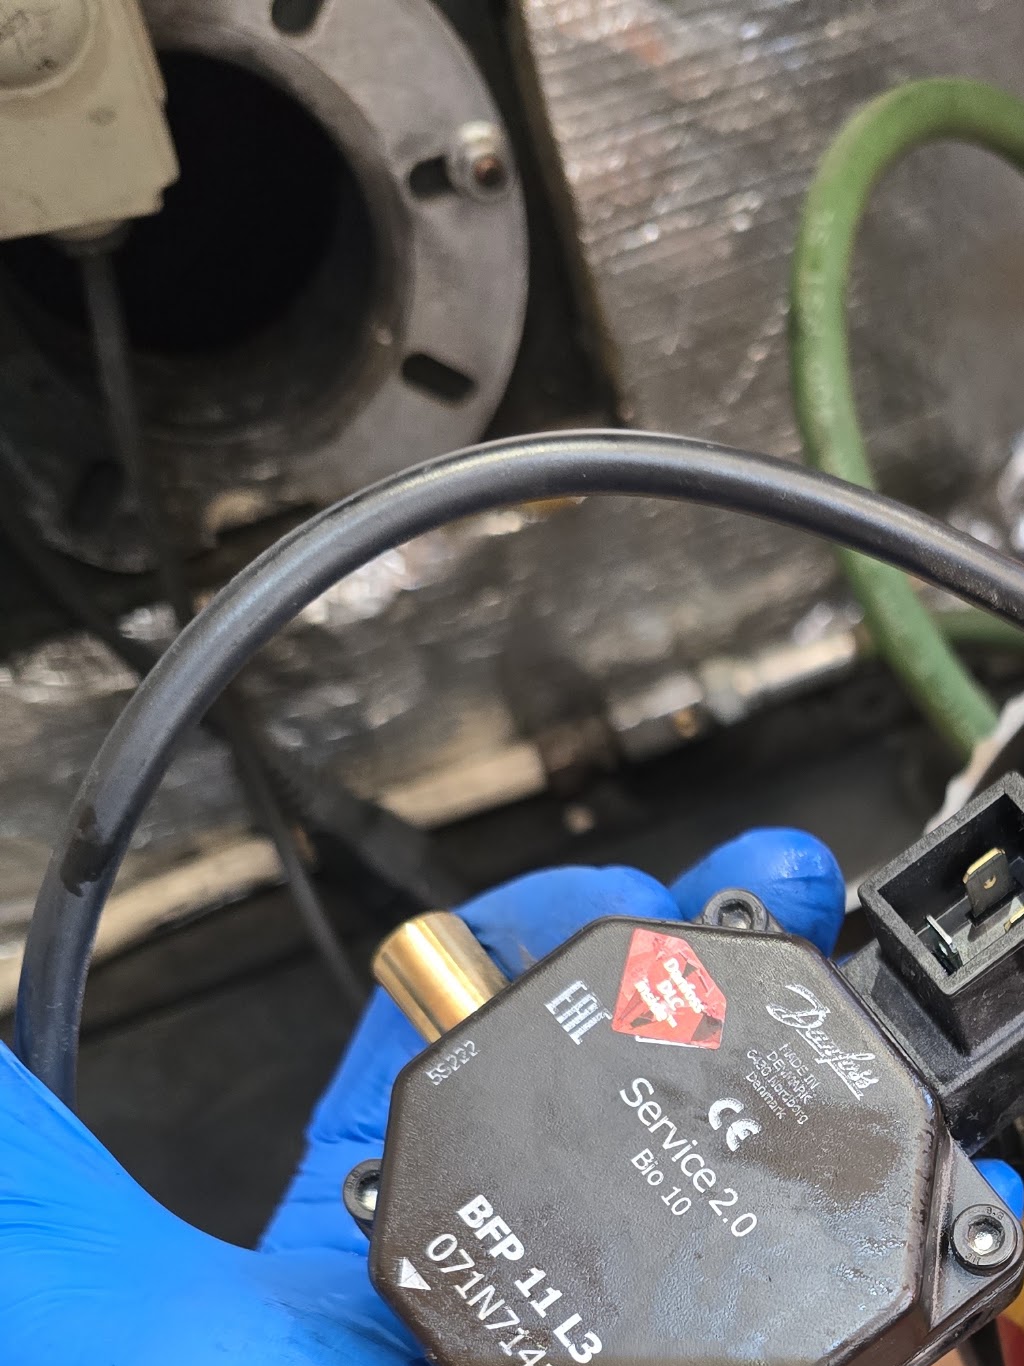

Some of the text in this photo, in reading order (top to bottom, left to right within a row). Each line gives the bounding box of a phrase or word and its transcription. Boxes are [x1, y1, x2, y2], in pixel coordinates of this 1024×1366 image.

[656, 979, 685, 1011] DLC
[745, 1071, 786, 1119] Denmark
[805, 1072, 821, 1090] IN
[708, 1097, 762, 1151] CE
[620, 1077, 757, 1237] Service 2.0
[631, 1148, 692, 1215] Bio 10
[456, 1195, 602, 1364] BFP 11 L3
